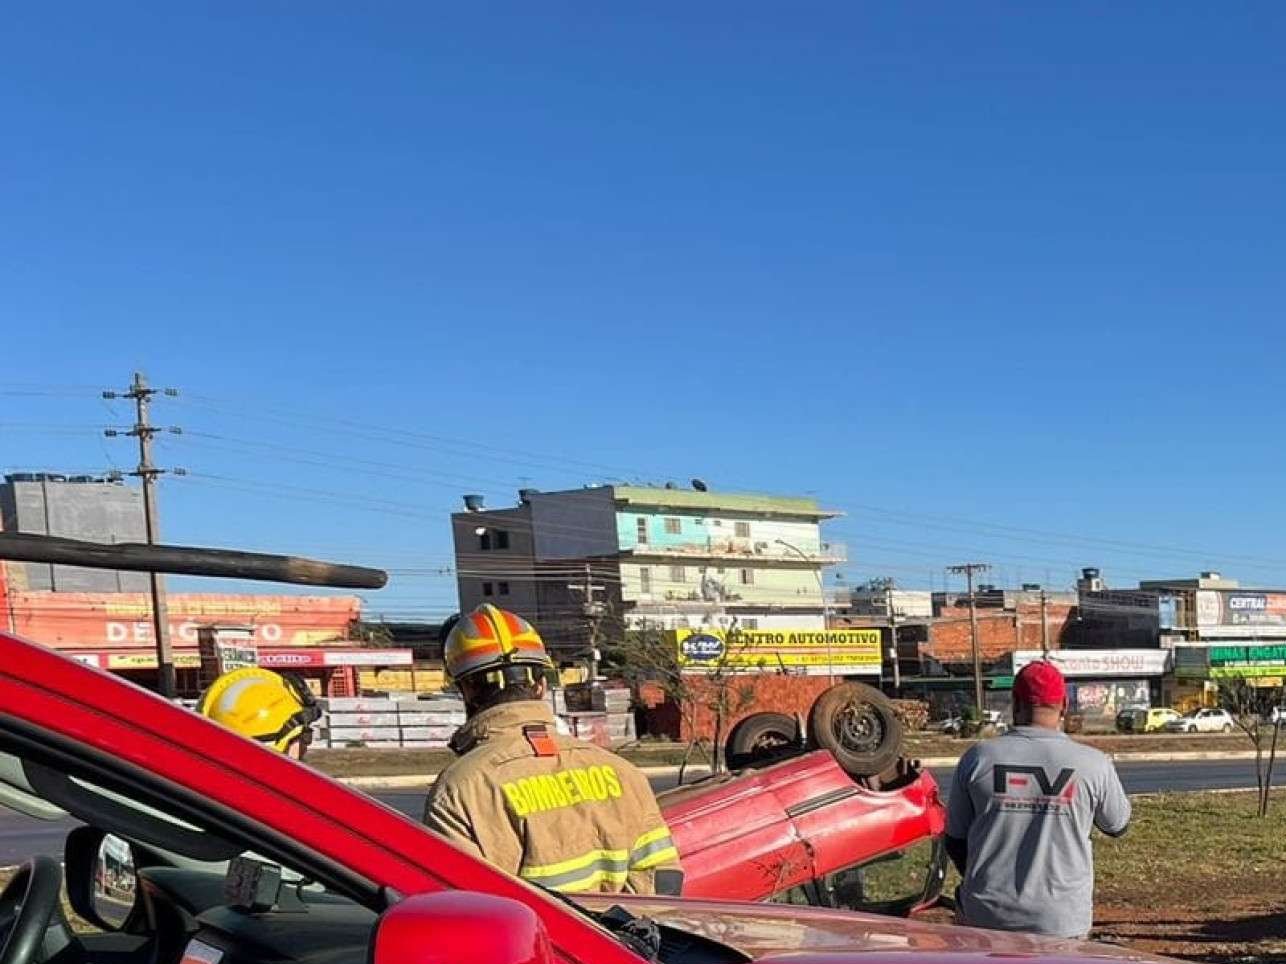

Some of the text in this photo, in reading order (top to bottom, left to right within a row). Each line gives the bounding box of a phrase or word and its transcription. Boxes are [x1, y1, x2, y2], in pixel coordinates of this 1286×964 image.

[106, 617, 283, 642] DEÓO
[788, 632, 878, 645] AUTOMOTIVO
[502, 765, 622, 816] BOMBEIROS
